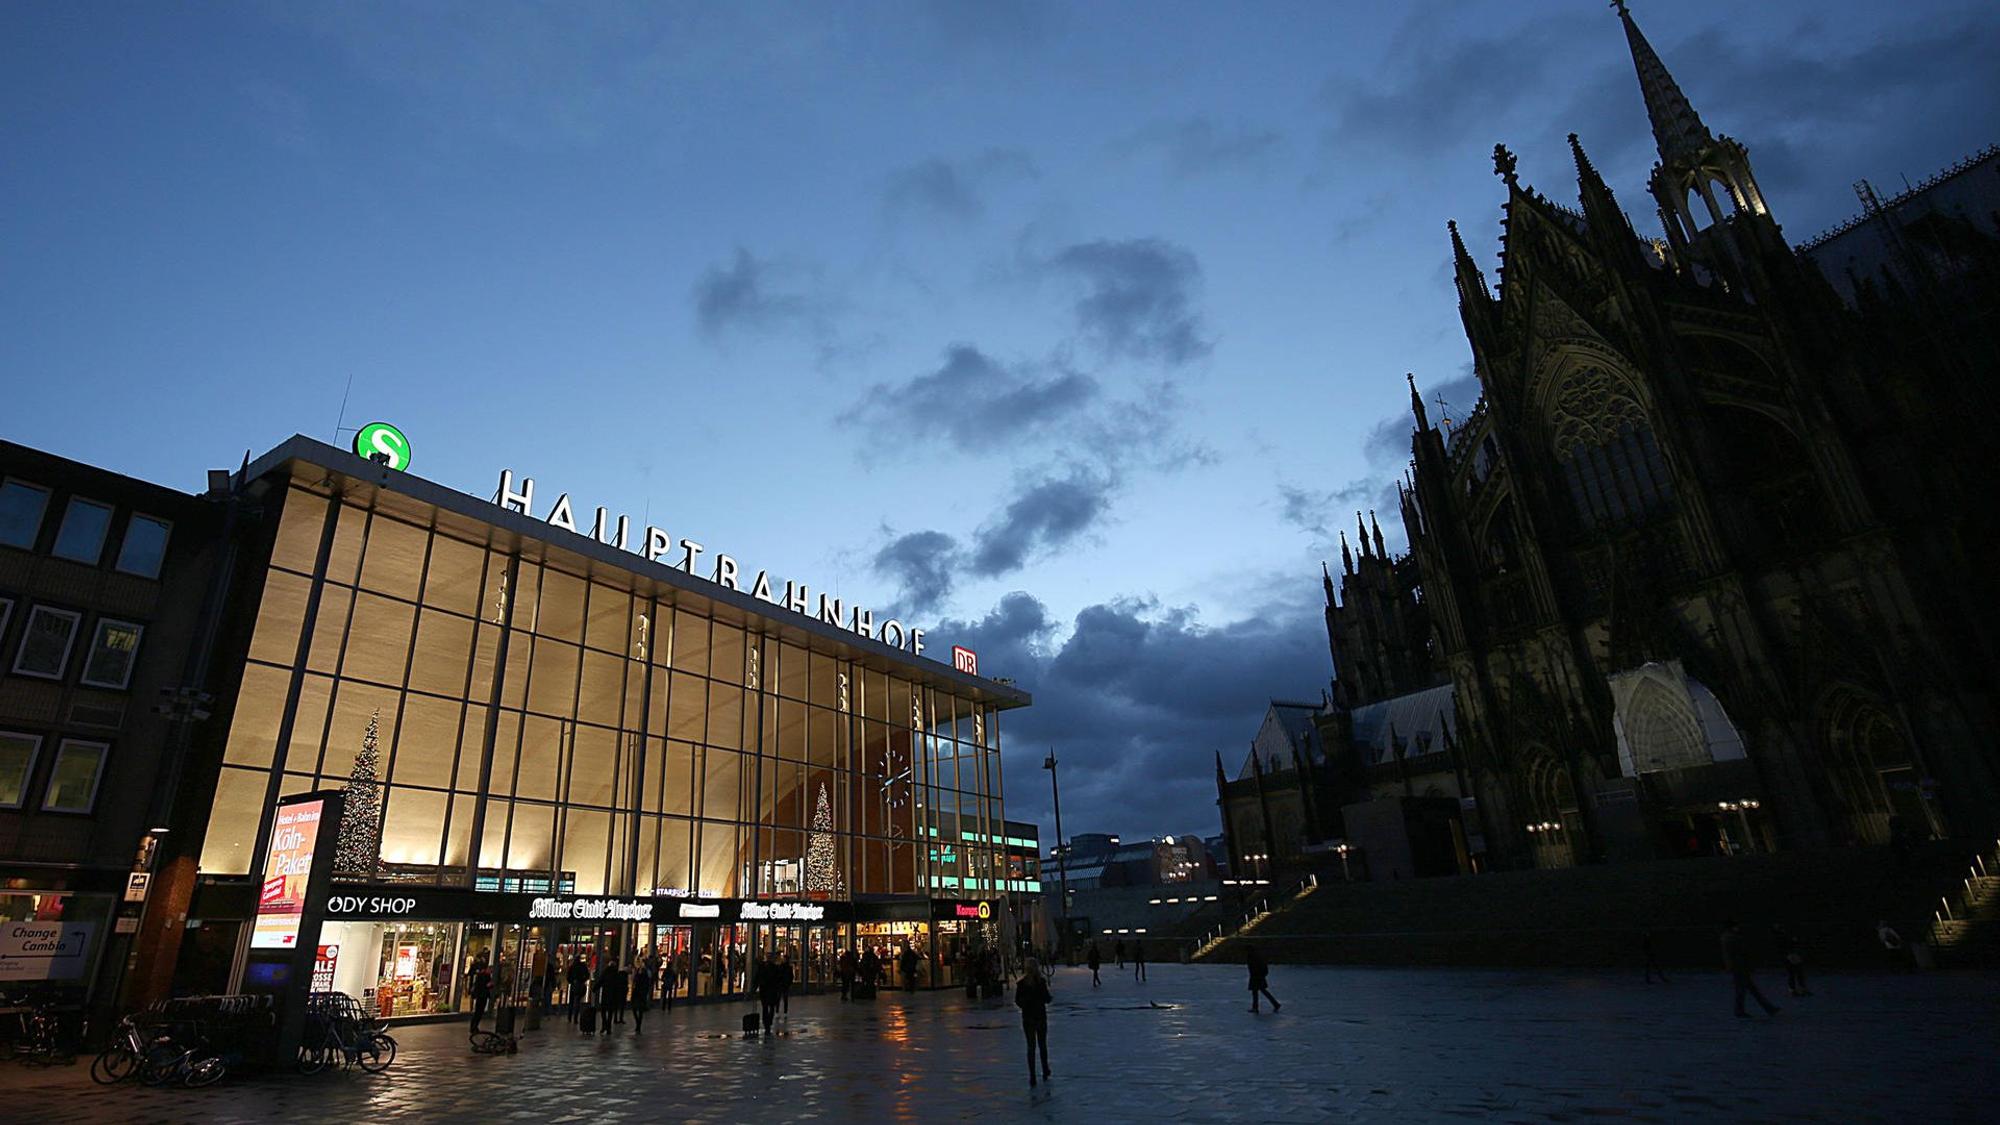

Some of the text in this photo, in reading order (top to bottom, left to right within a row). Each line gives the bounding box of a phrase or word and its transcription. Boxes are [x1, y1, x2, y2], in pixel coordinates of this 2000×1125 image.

[366, 428, 402, 469] S
[499, 469, 925, 656] HAUPTBAHNHOF
[955, 648, 977, 675] DB
[273, 826, 306, 850] Köln-
[275, 851, 312, 876] Paket
[370, 897, 416, 914] SHOP
[12, 927, 57, 940] Change
